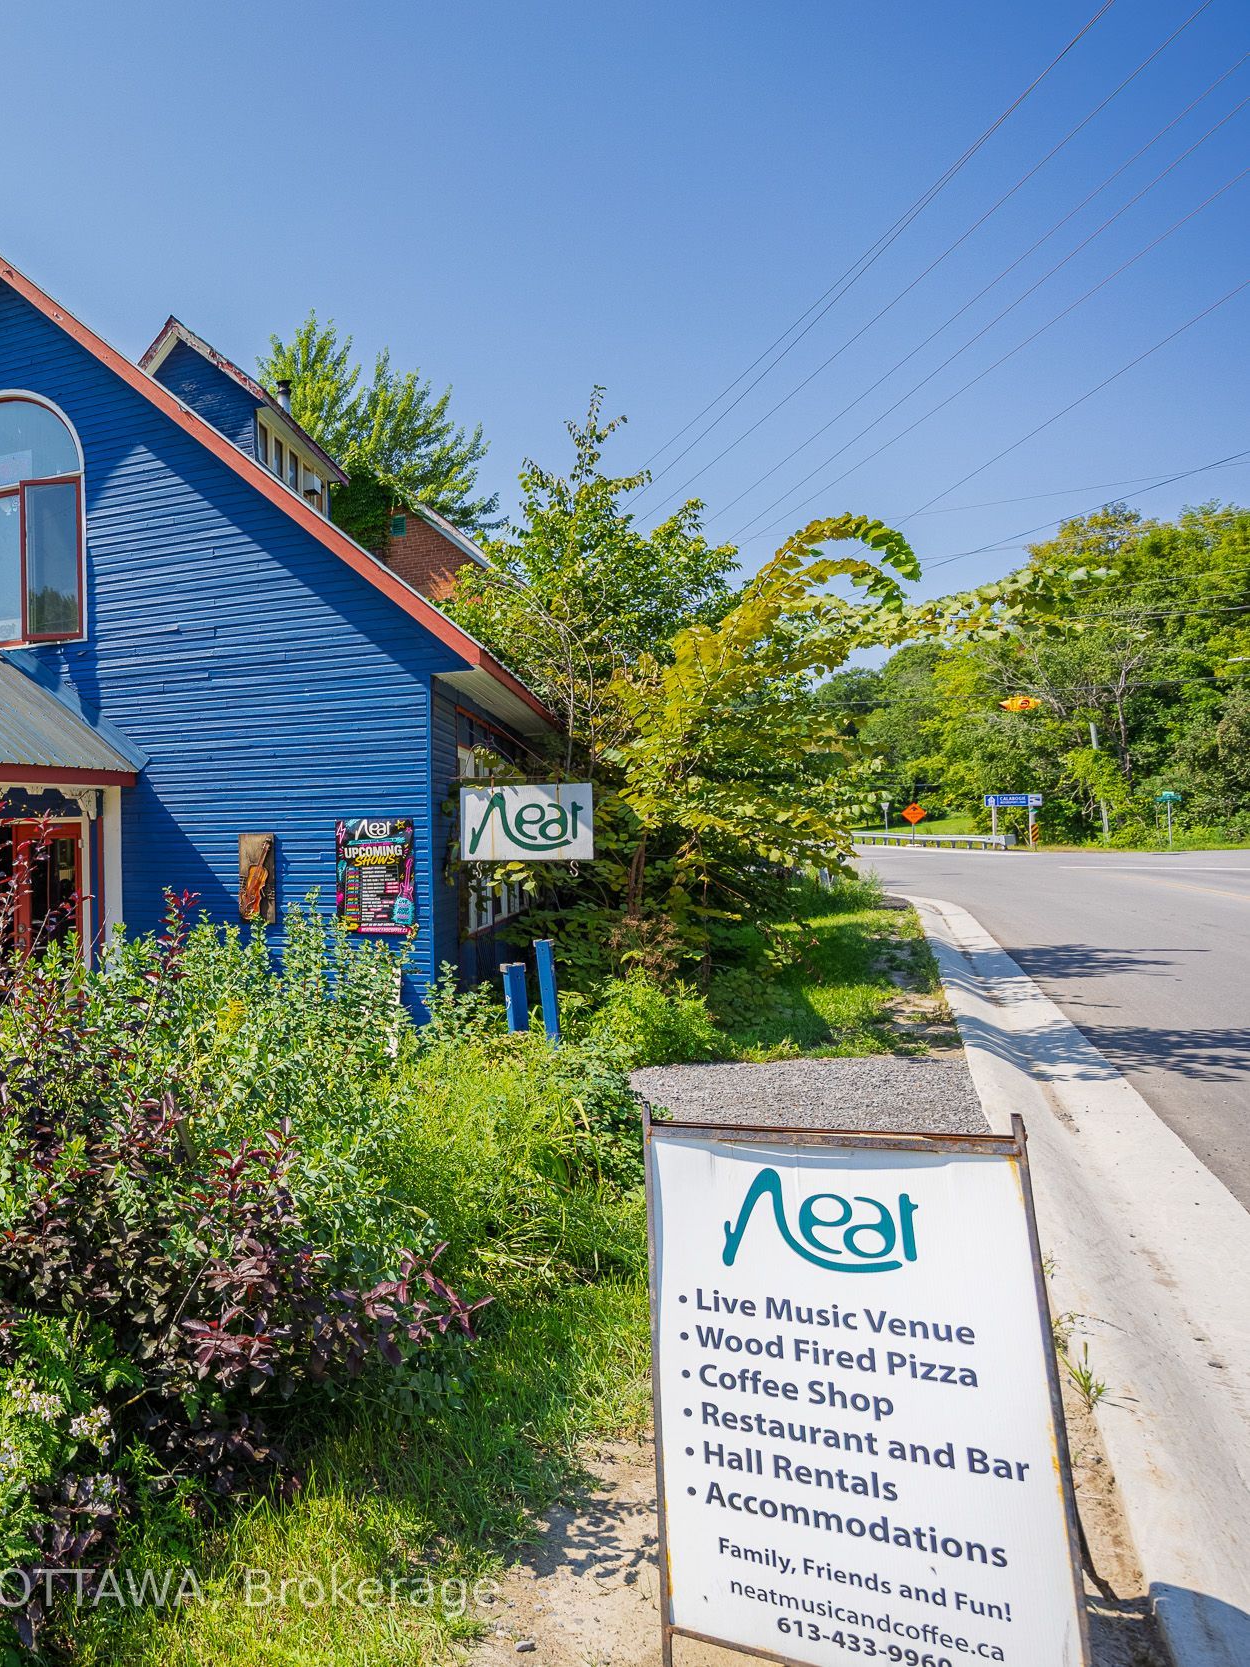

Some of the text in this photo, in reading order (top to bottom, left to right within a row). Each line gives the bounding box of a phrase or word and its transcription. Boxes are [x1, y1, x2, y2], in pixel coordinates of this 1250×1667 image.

[344, 844, 403, 859] UPCOMING
[354, 853, 396, 867] SHOWS
[696, 1288, 976, 1345] Live Music Venue
[695, 1325, 979, 1388] Wood Fired Pizza
[699, 1364, 894, 1421] Coffee Shop
[701, 1401, 1030, 1482] Restaurant and Bar
[703, 1441, 899, 1502] Hall Rentals
[705, 1481, 1009, 1568] Accommodations
[718, 1537, 1013, 1623] Family, Friends and Fun!
[730, 1579, 1005, 1662] neatmusicandcoffee.ca
